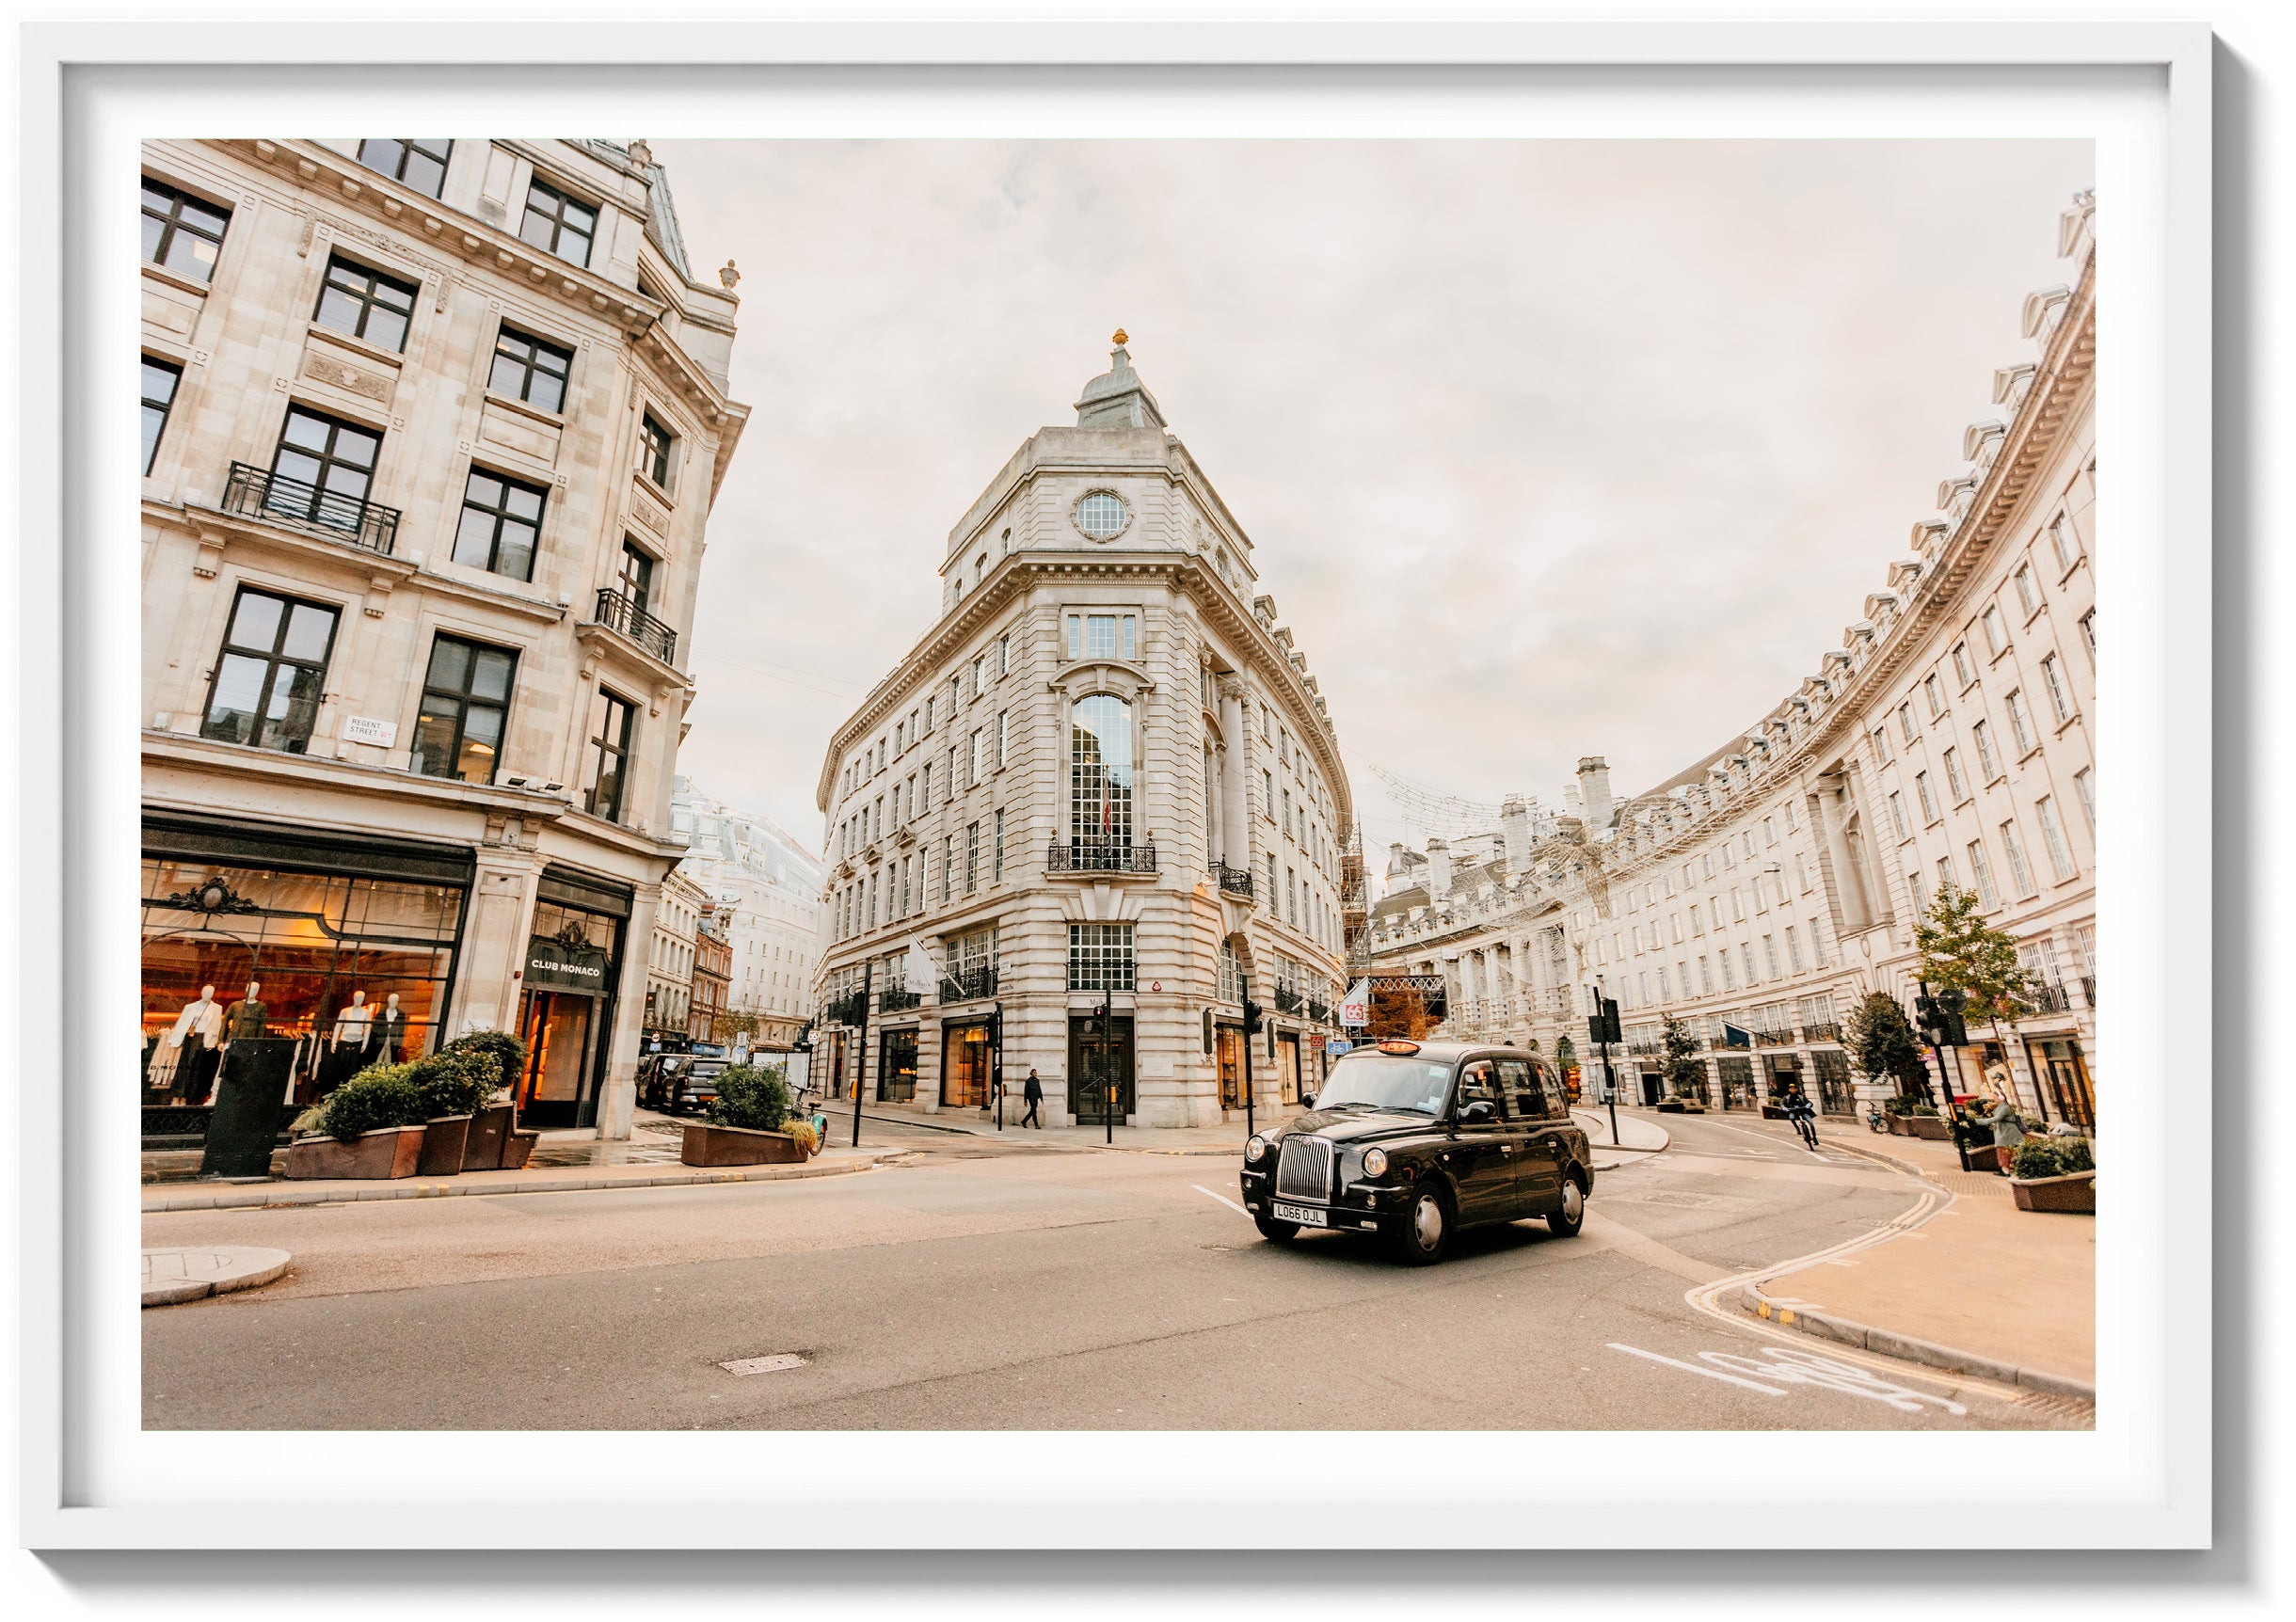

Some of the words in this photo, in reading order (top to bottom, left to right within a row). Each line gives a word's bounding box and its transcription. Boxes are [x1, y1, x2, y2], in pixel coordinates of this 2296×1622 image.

[352, 718, 381, 729] REGENT
[349, 725, 378, 737] STREET
[532, 959, 559, 971] CLUB
[560, 963, 600, 977] MONACO
